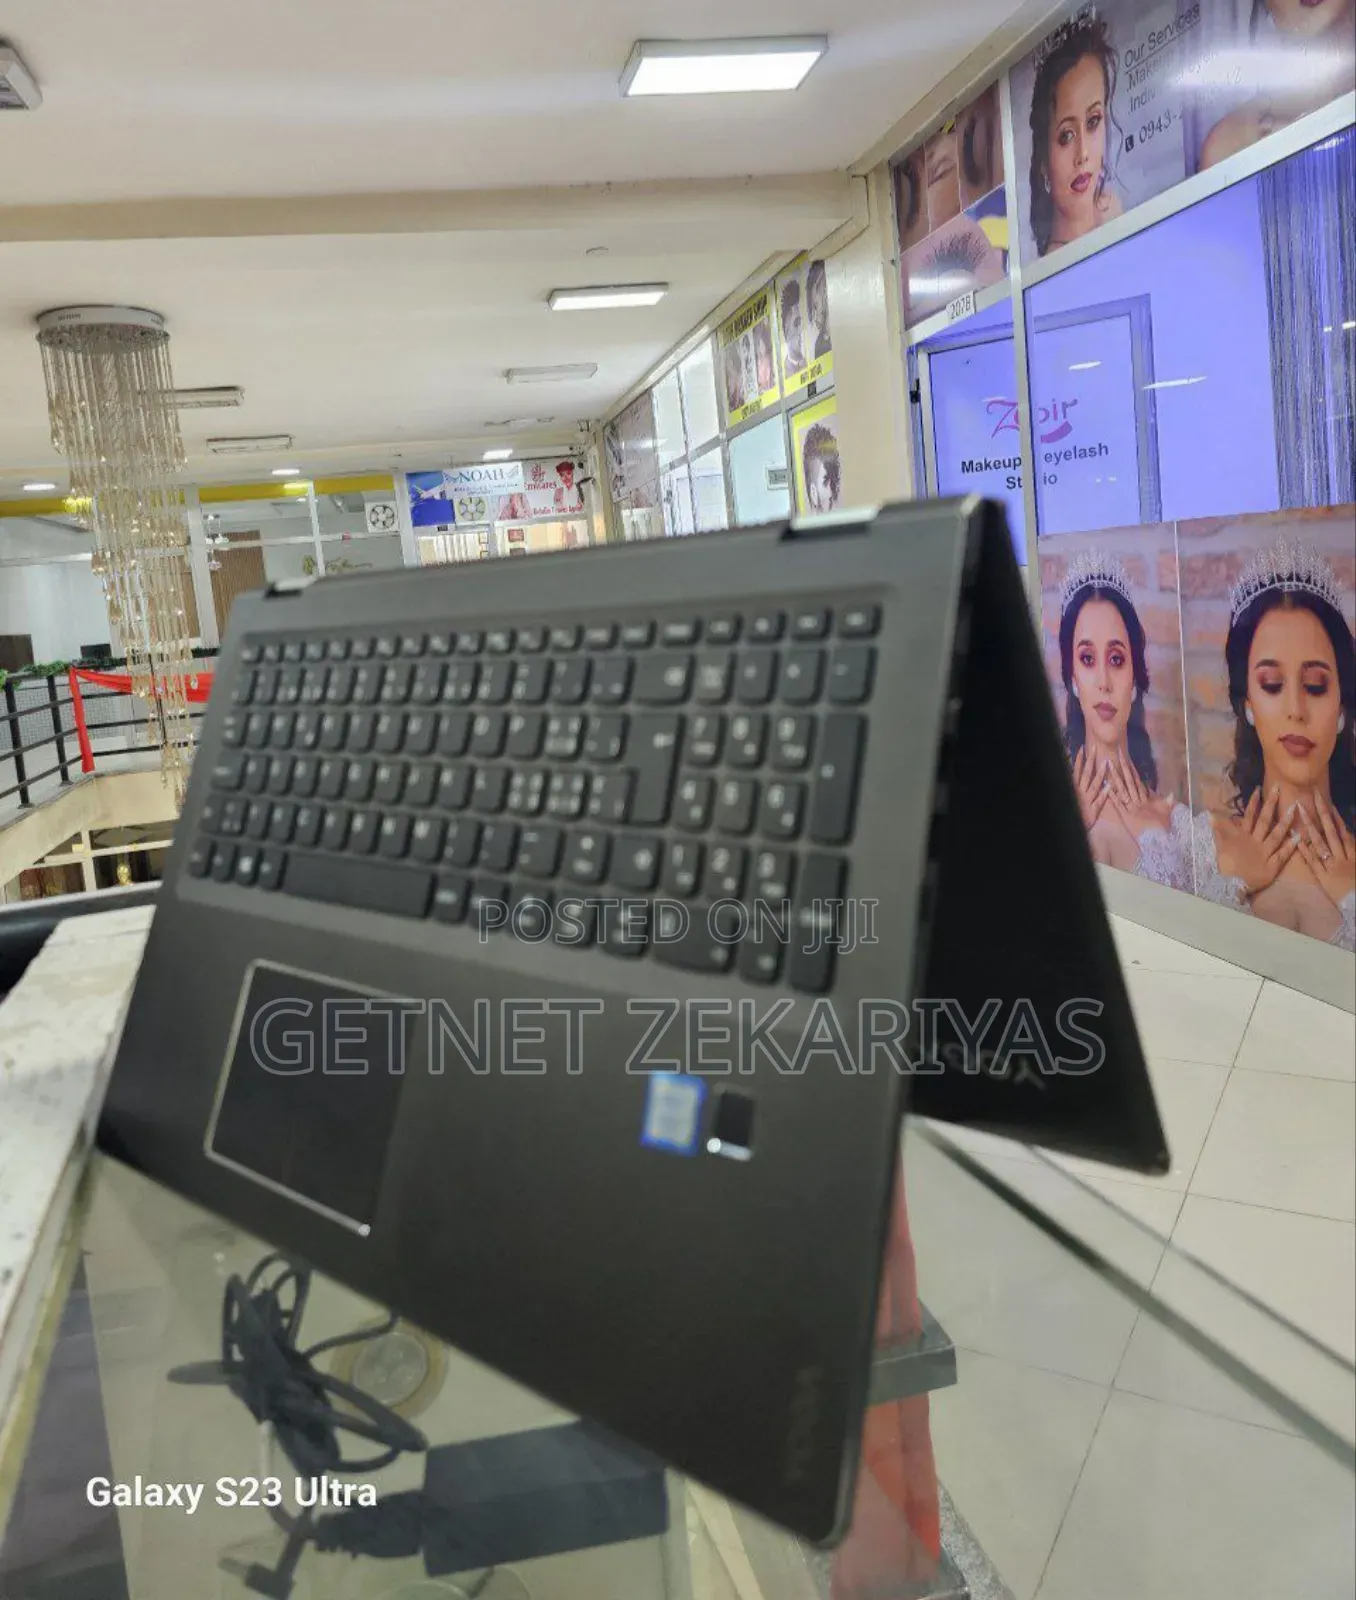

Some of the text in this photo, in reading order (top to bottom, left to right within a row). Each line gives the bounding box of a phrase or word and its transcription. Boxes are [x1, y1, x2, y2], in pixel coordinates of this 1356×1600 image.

[1124, 4, 1201, 68] Our Services
[961, 442, 1109, 474] Makeup eyelash
[459, 467, 506, 483] NOAH
[1006, 473, 1058, 490] Stio
